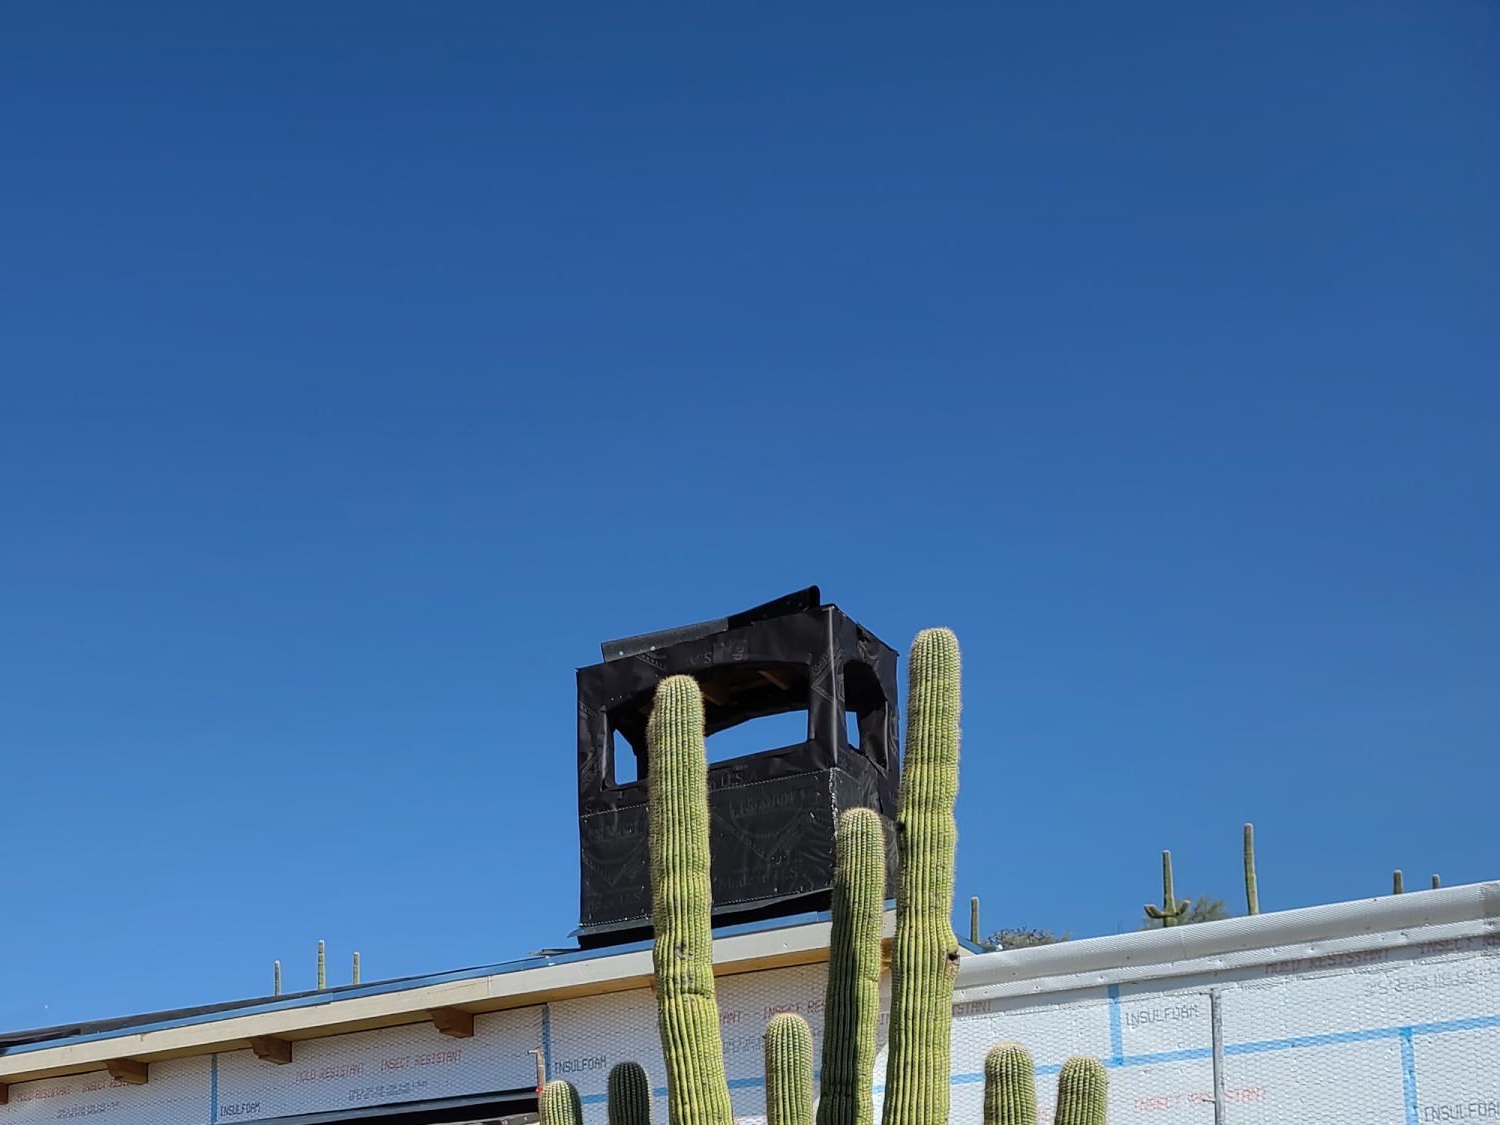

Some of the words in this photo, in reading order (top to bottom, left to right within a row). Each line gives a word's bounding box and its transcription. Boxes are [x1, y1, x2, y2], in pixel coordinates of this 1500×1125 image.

[1125, 1005, 1199, 1027] INSULFOAM
[321, 1063, 364, 1079] RESISTANT
[380, 1058, 410, 1072] INSECT
[414, 1050, 462, 1066] RESISTANT
[555, 1056, 606, 1073] INSULFOAM
[220, 1102, 261, 1116] INSULFOAM
[1425, 1102, 1500, 1121] INSULFOA
